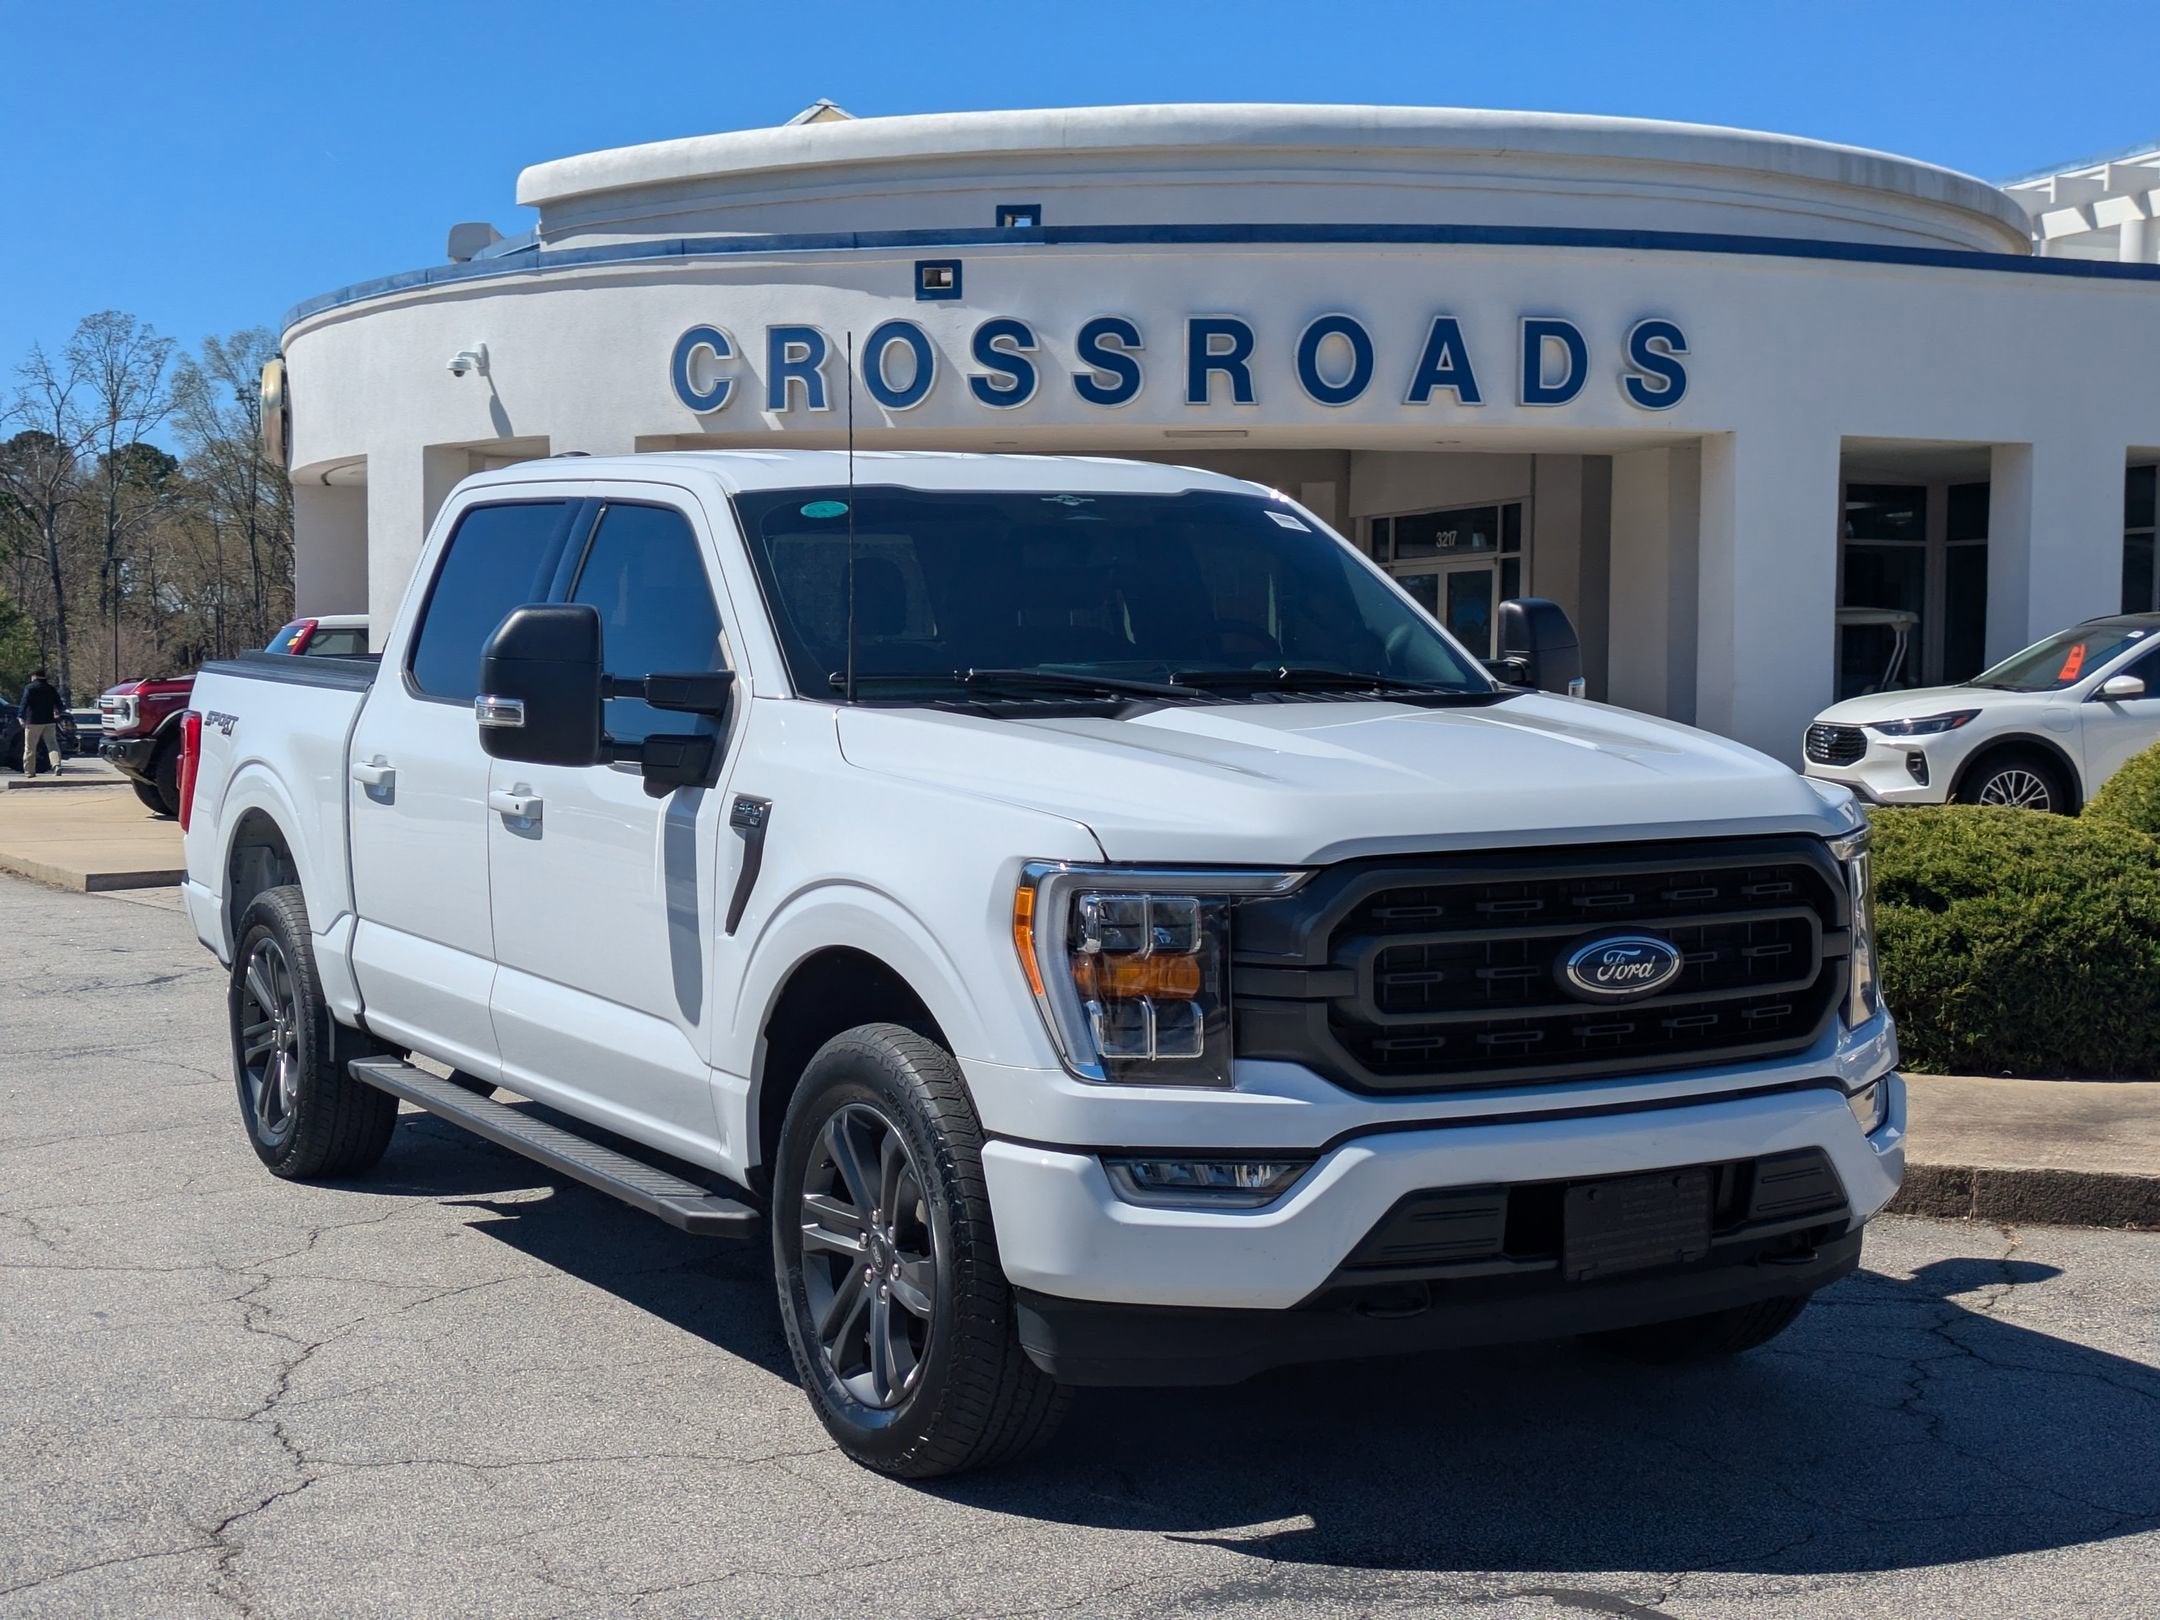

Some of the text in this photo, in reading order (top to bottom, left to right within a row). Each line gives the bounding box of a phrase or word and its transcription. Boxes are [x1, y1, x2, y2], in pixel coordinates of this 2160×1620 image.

[670, 313, 1690, 415] CROSSROADS
[1436, 531, 1457, 547] 3217
[205, 710, 239, 736] SPORT
[1597, 950, 1655, 981] Ford
